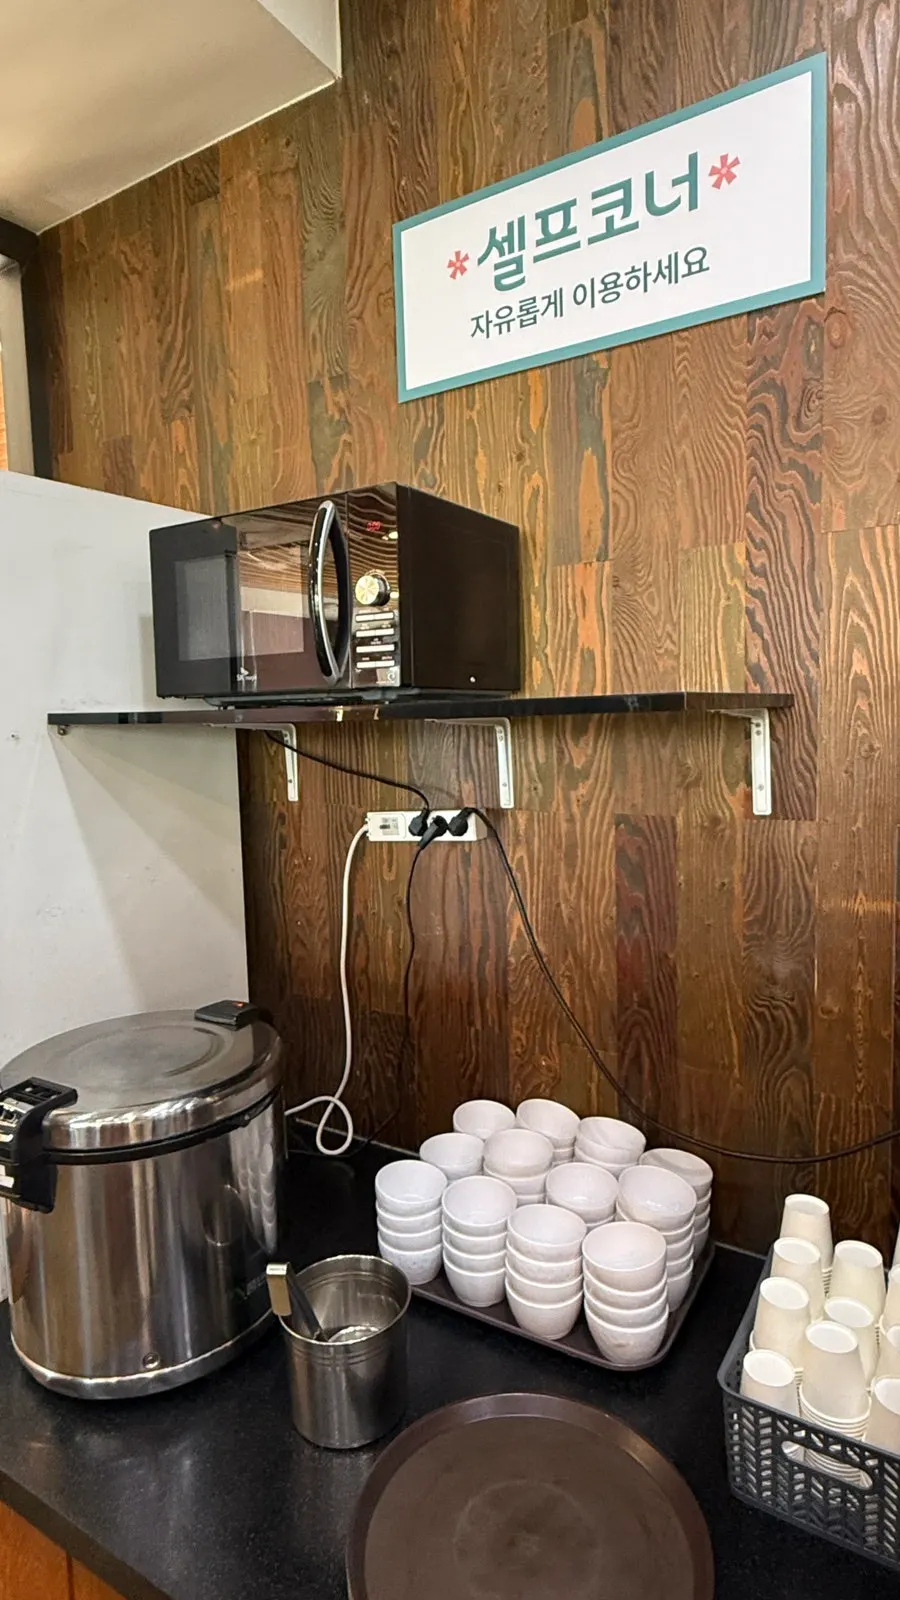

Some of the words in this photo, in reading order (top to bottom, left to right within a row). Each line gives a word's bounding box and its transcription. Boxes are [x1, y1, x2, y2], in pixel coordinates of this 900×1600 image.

[477, 151, 698, 292] 셀프코너
[470, 287, 564, 340] 자유롭게
[572, 246, 710, 310] 이용하세요
